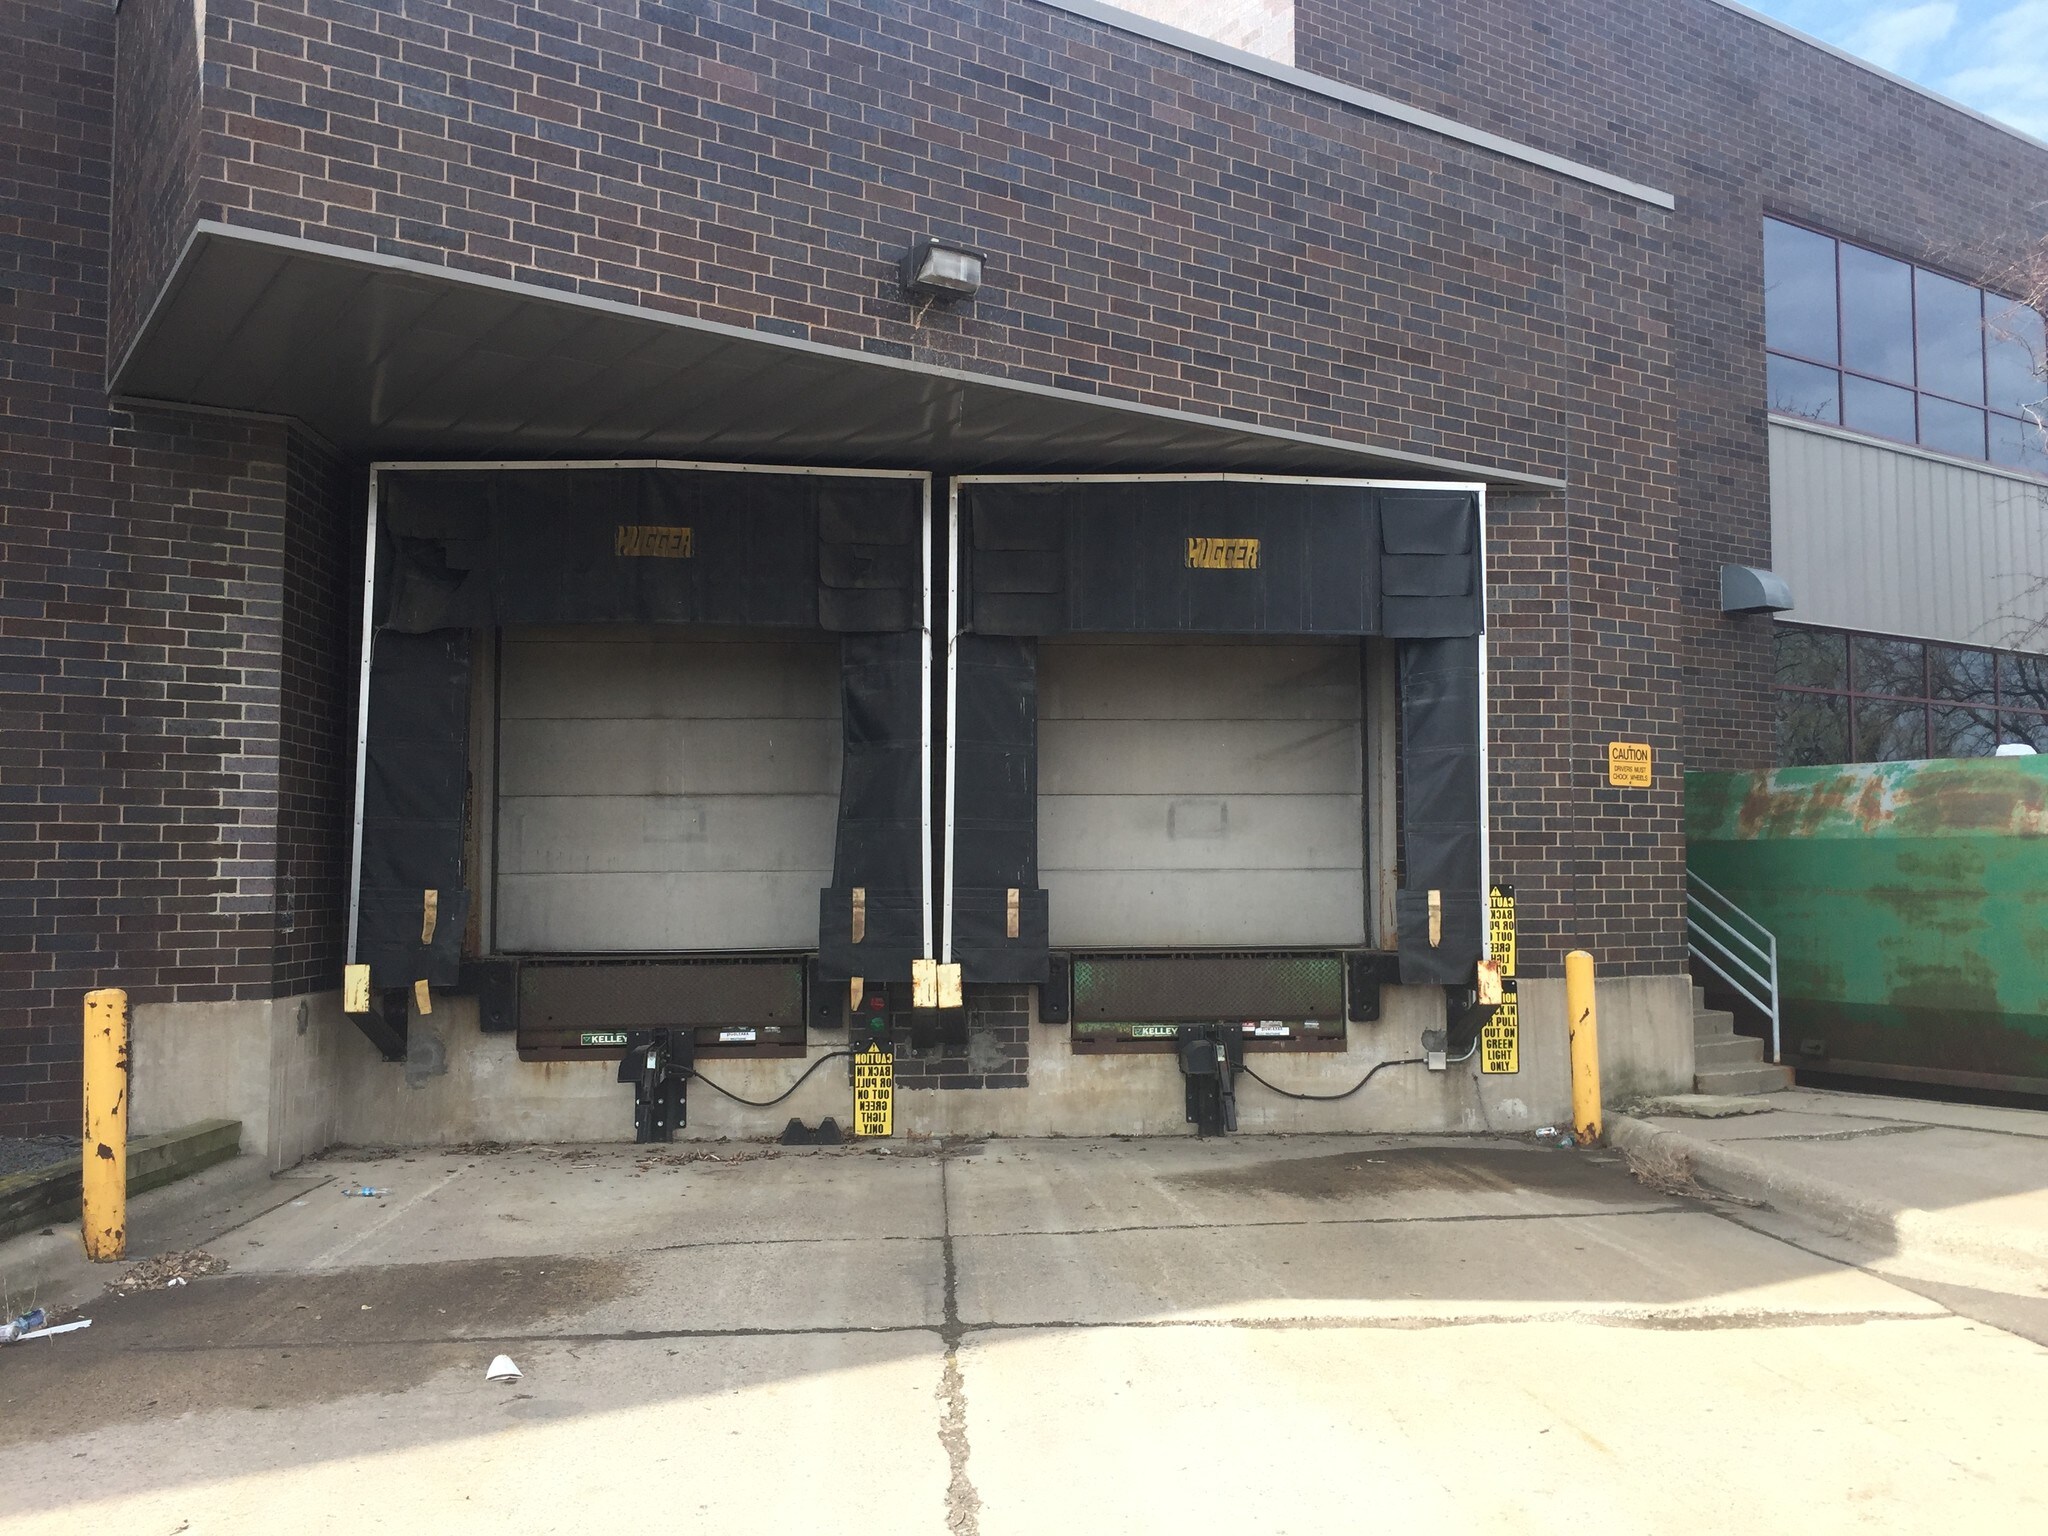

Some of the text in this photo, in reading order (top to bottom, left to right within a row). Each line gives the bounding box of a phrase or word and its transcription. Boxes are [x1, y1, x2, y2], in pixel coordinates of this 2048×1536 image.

[1612, 747, 1648, 761] CAUTION
[1614, 765, 1633, 773] DRIVERS
[1630, 774, 1648, 782] WHEELS
[1507, 1006, 1515, 1015] IN
[1496, 1017, 1517, 1027] PULL
[1142, 1027, 1178, 1035] KELLEY
[1484, 1028, 1515, 1037] OUT ON
[592, 1035, 627, 1043] KELLEY
[1486, 1039, 1513, 1049] GREEN
[1487, 1050, 1511, 1060] LIGHT
[1490, 1062, 1509, 1071] ONLY
